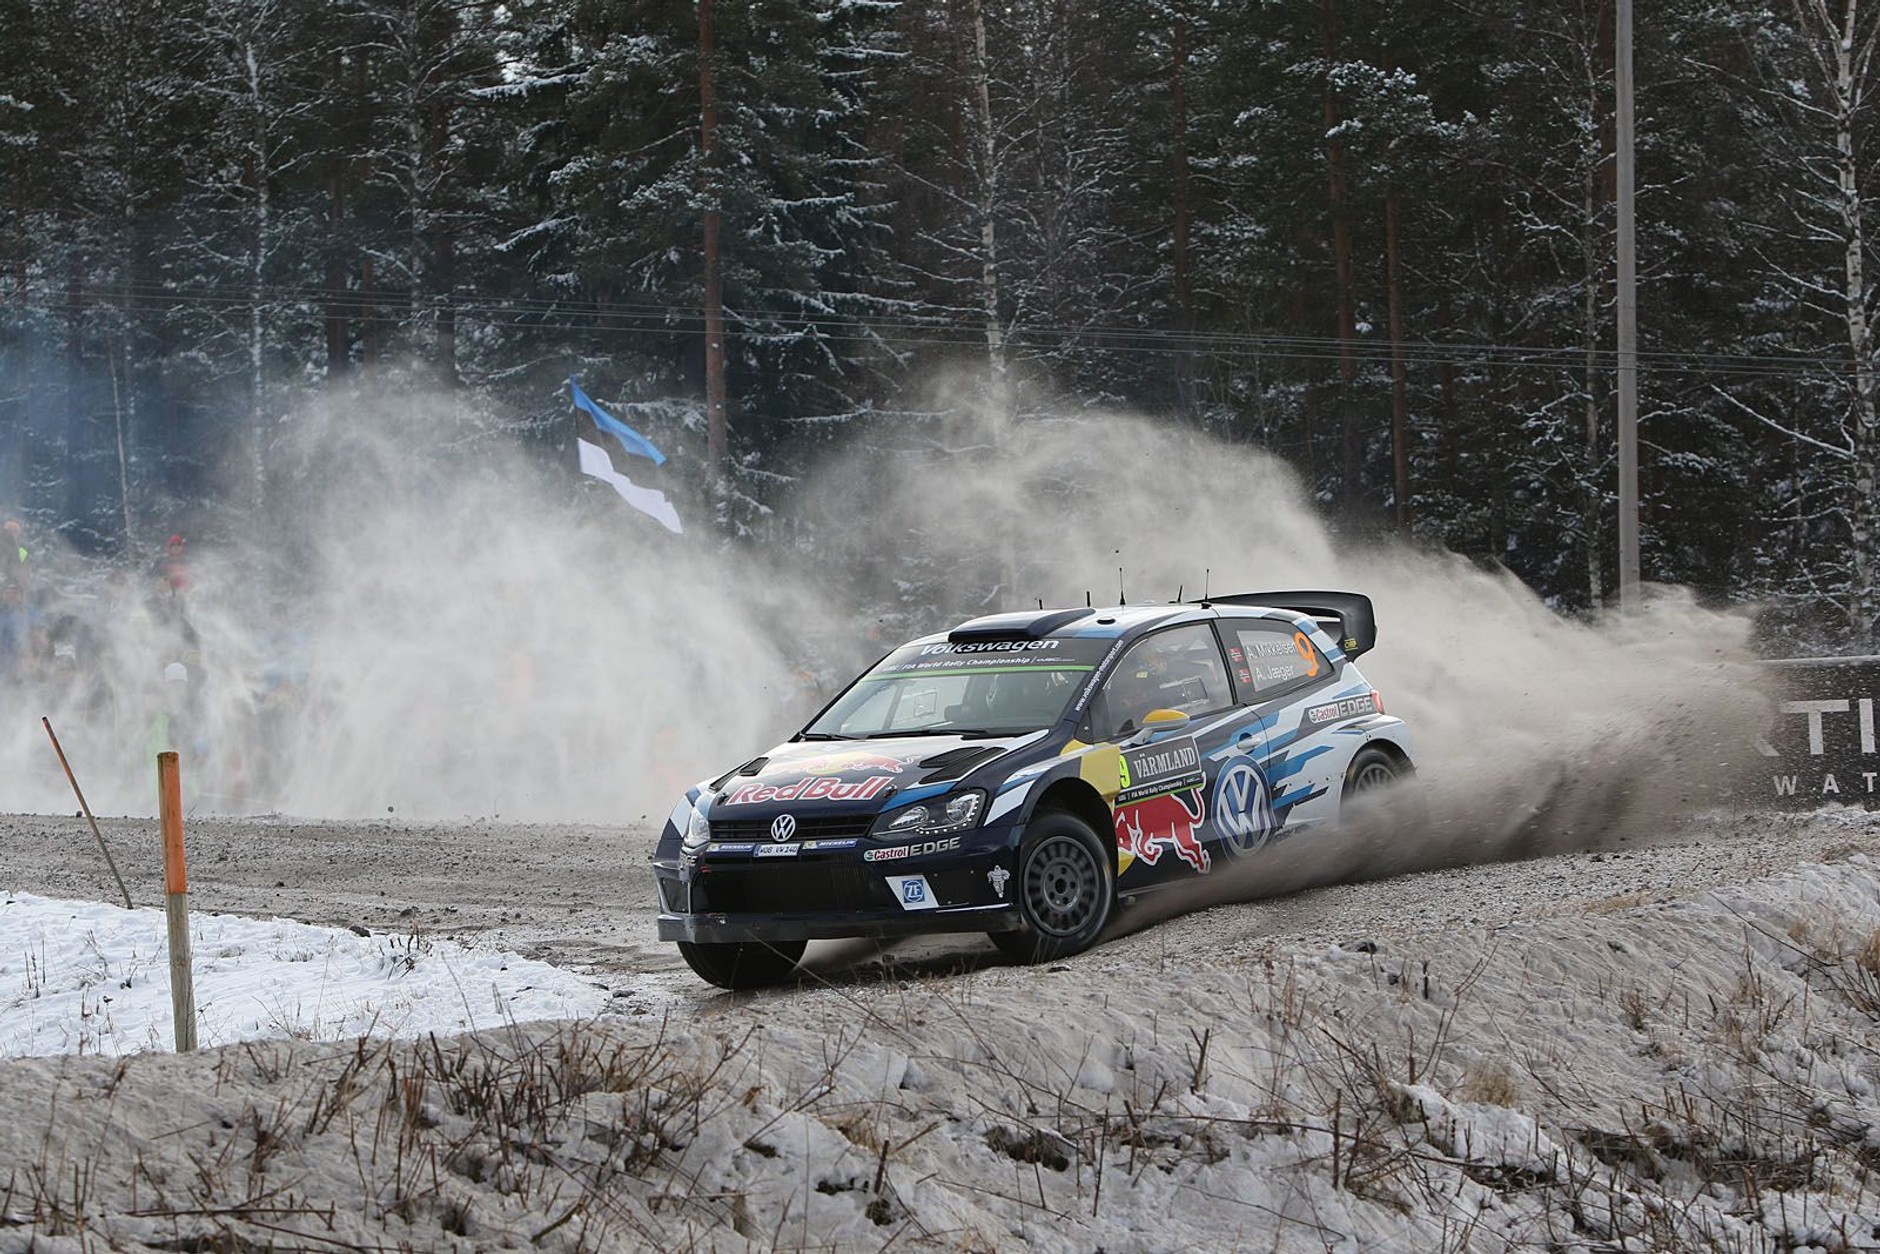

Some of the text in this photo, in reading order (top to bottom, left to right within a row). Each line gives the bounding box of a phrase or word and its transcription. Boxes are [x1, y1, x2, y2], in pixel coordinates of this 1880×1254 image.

[920, 639, 1060, 656] Volkswagen
[1246, 641, 1297, 660] A. Mikkelsen
[1294, 631, 1318, 678] 9
[917, 661, 943, 669] World
[943, 660, 965, 668] Rally
[966, 657, 1030, 665] Championship
[1255, 667, 1266, 681] A.
[1339, 697, 1373, 715] EDGE
[1119, 747, 1196, 788] 9 VÄRMLAND
[874, 837, 961, 860] Castrol EDGE
